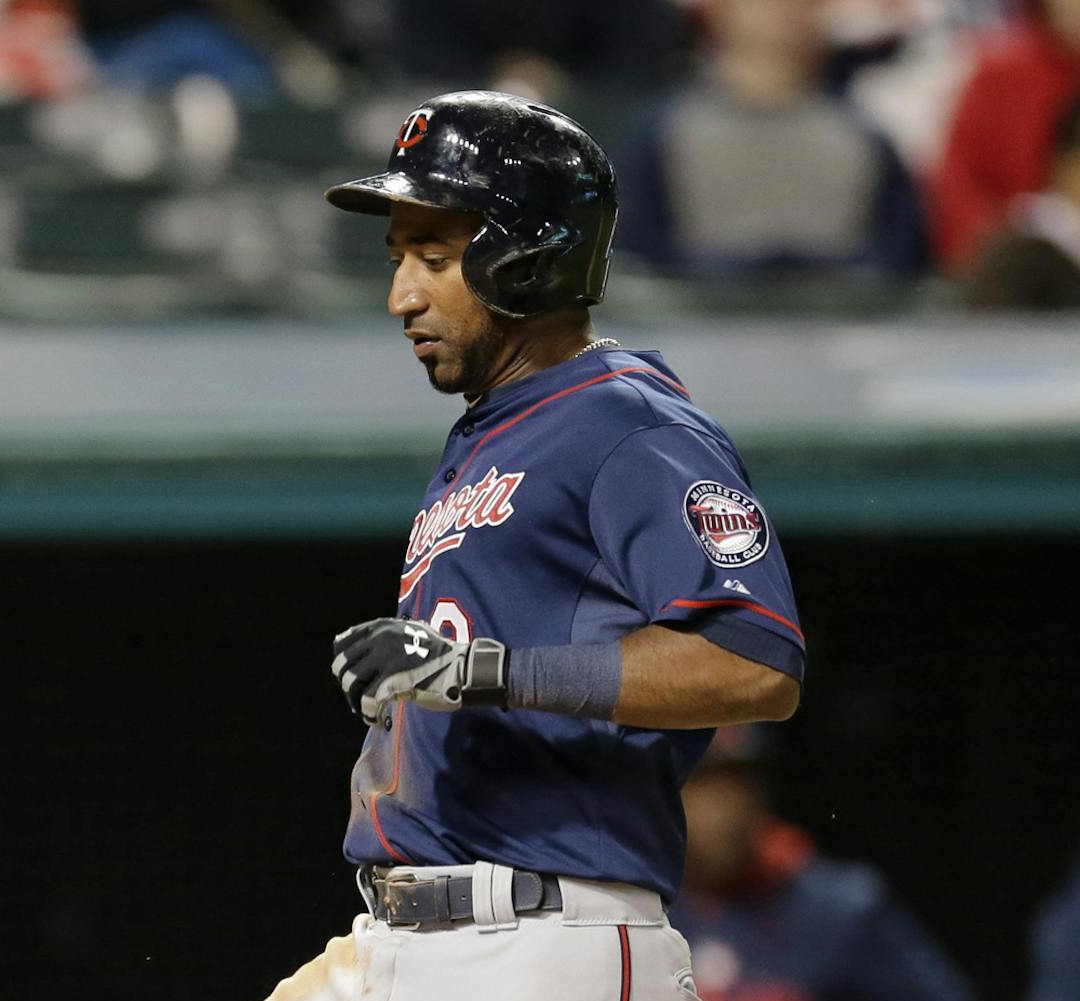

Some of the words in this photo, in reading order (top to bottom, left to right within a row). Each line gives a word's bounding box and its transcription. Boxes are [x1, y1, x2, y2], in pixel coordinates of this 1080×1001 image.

[690, 485, 755, 513] MINNESOTA
[688, 504, 761, 542] Twins
[700, 534, 741, 563] BASEBALL
[743, 542, 762, 559] CLUB
